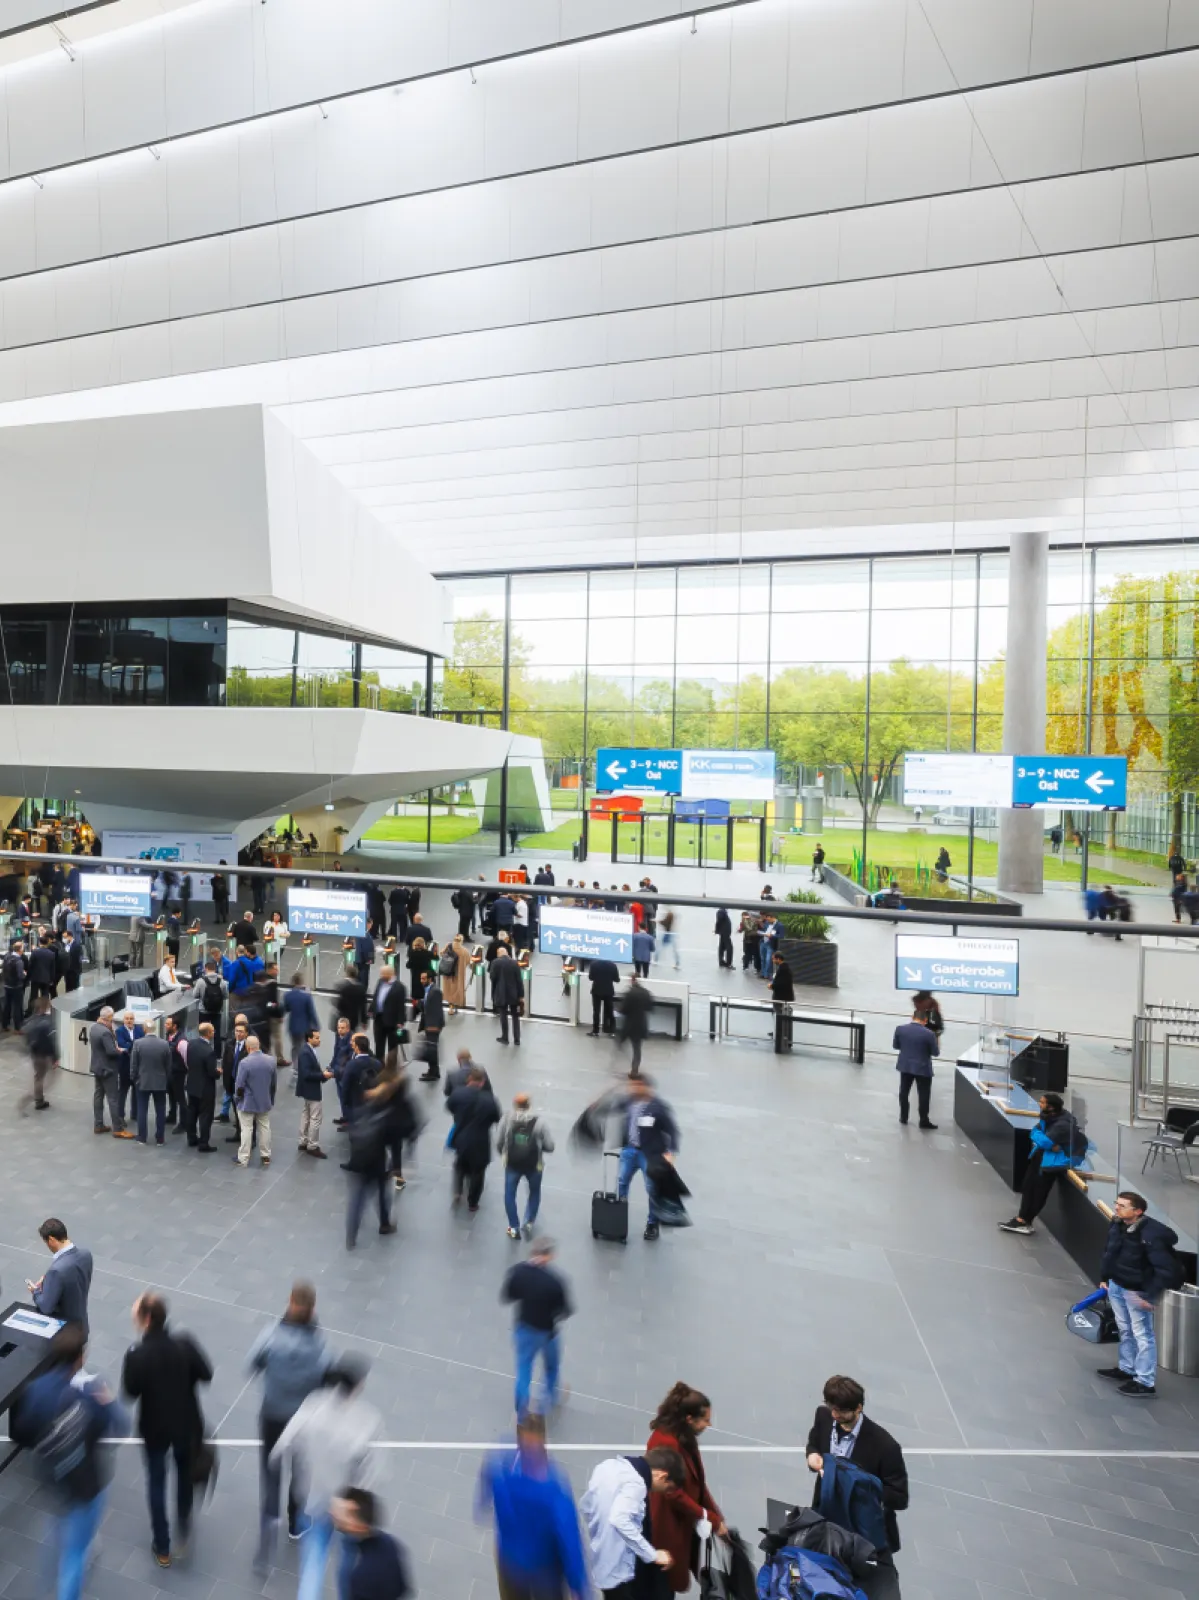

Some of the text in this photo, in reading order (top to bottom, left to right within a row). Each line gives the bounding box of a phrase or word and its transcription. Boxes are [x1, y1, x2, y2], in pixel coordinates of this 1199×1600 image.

[658, 760, 679, 770] NCC
[1054, 769, 1080, 779] NCC
[1038, 781, 1059, 791] Ost
[105, 893, 139, 905] Clearing
[304, 910, 349, 922] Fast Lane
[304, 921, 339, 932] e-ticket
[560, 931, 612, 945] Fast Lane
[560, 943, 600, 955] e-ticket
[931, 963, 1006, 977] Garderobe
[931, 976, 1012, 991] Cloak room
[78, 1026, 89, 1046] 4
